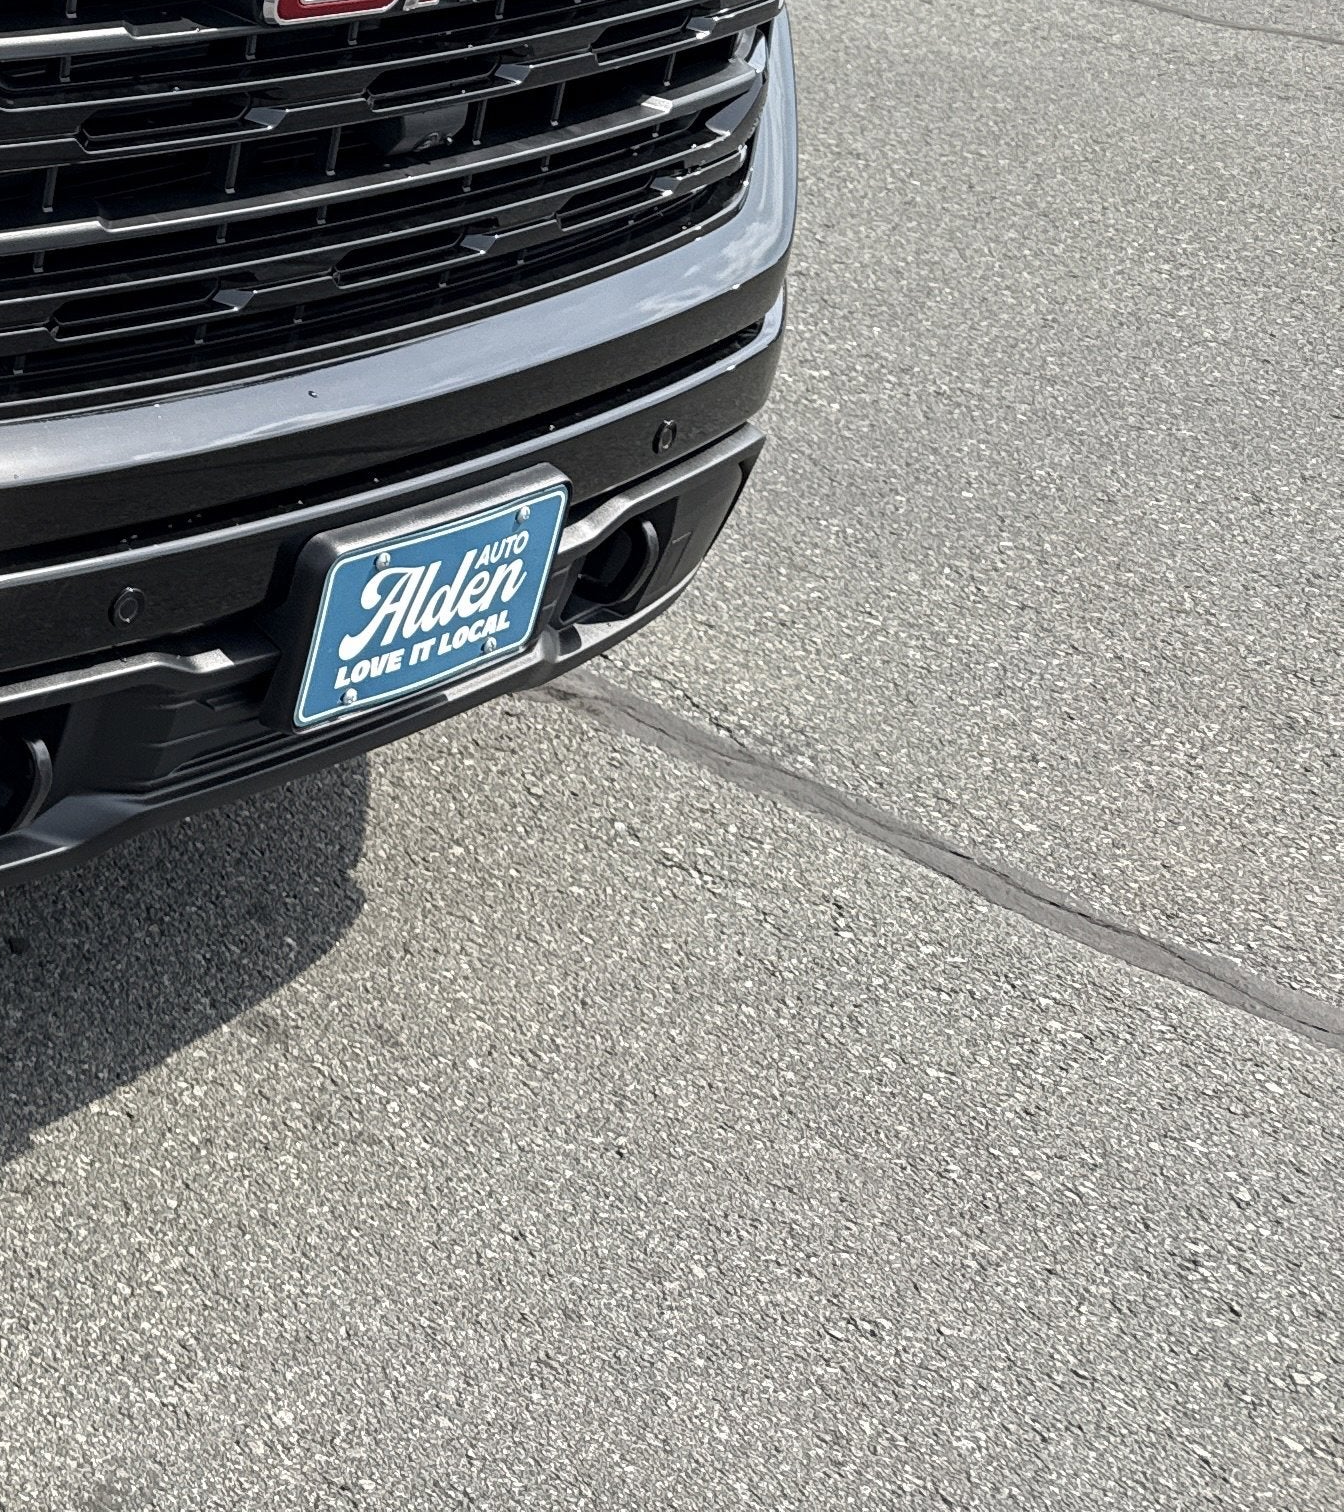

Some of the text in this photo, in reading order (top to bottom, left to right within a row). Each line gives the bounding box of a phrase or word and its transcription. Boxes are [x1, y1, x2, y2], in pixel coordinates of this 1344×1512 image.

[476, 530, 530, 570] AUTO
[338, 547, 528, 661] Alden
[333, 609, 511, 690] LOVE IT LOCAL
